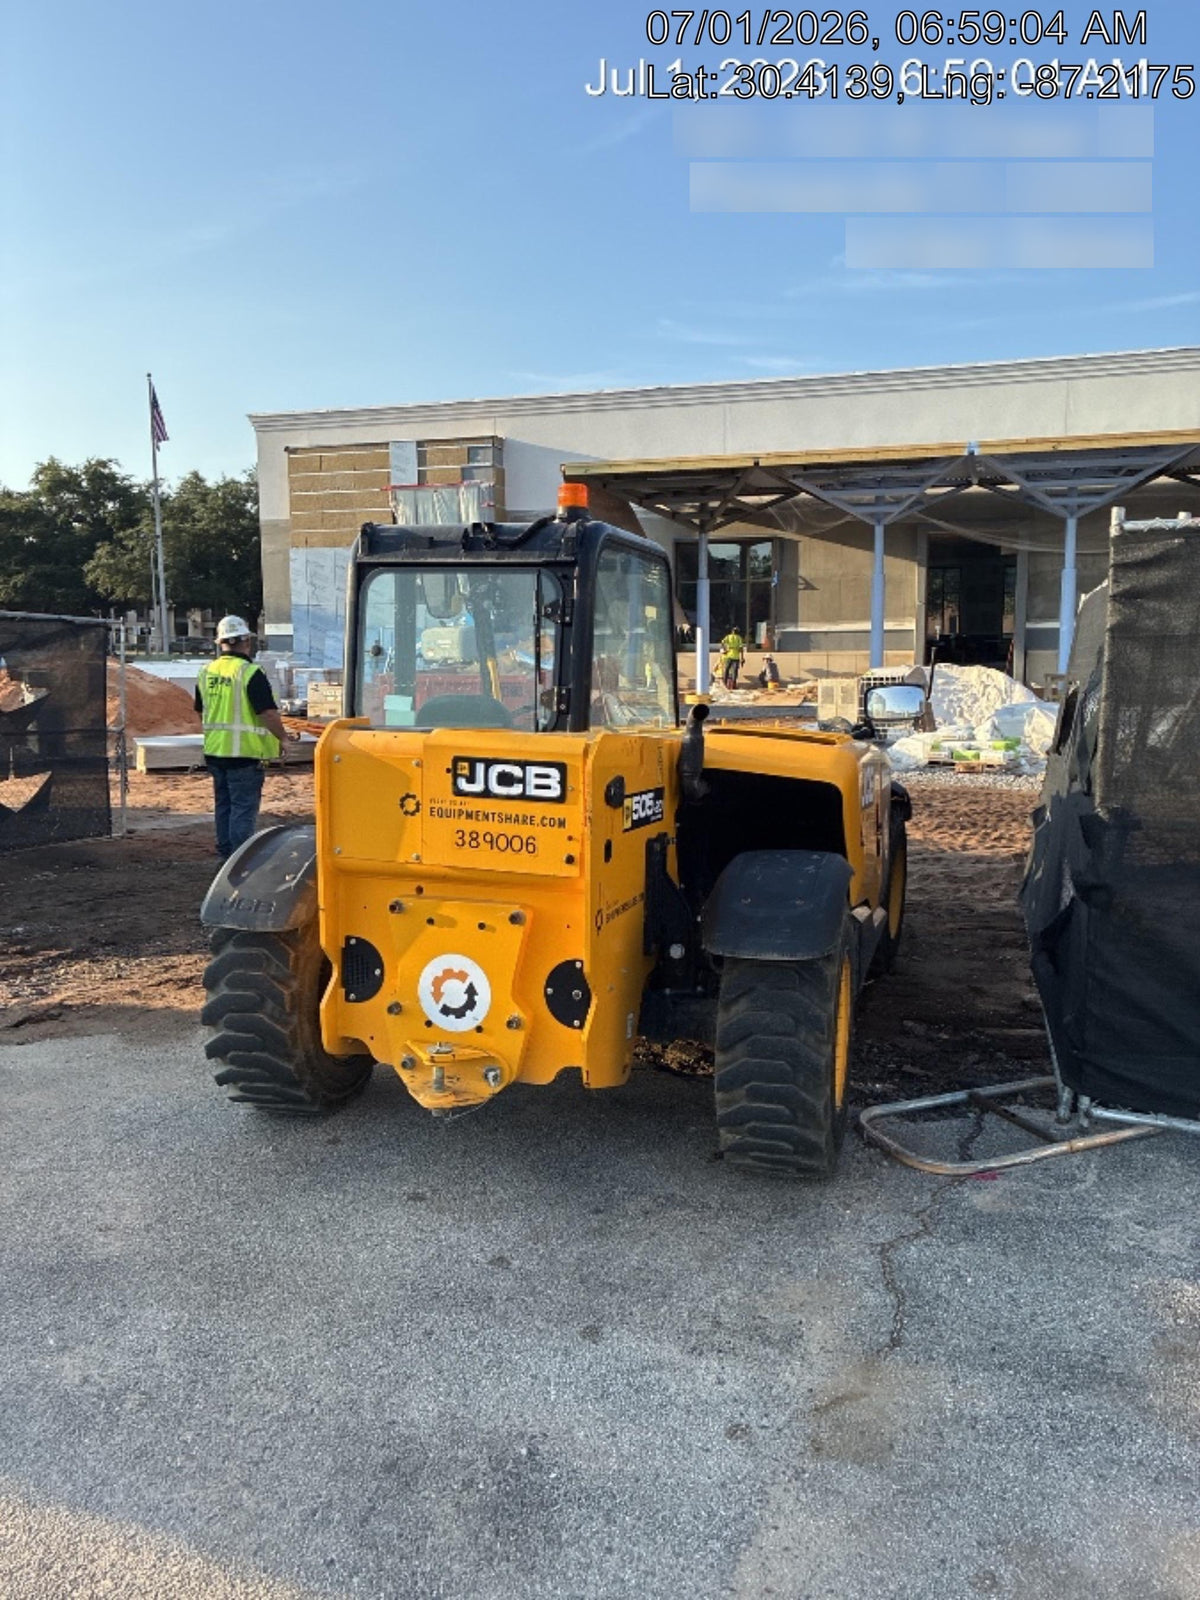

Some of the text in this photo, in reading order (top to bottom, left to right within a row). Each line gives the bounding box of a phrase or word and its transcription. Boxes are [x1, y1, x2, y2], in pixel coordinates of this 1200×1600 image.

[456, 761, 562, 798] JCB
[429, 806, 567, 829] EQUIPMENTSHARE.COM
[455, 829, 537, 854] 389006
